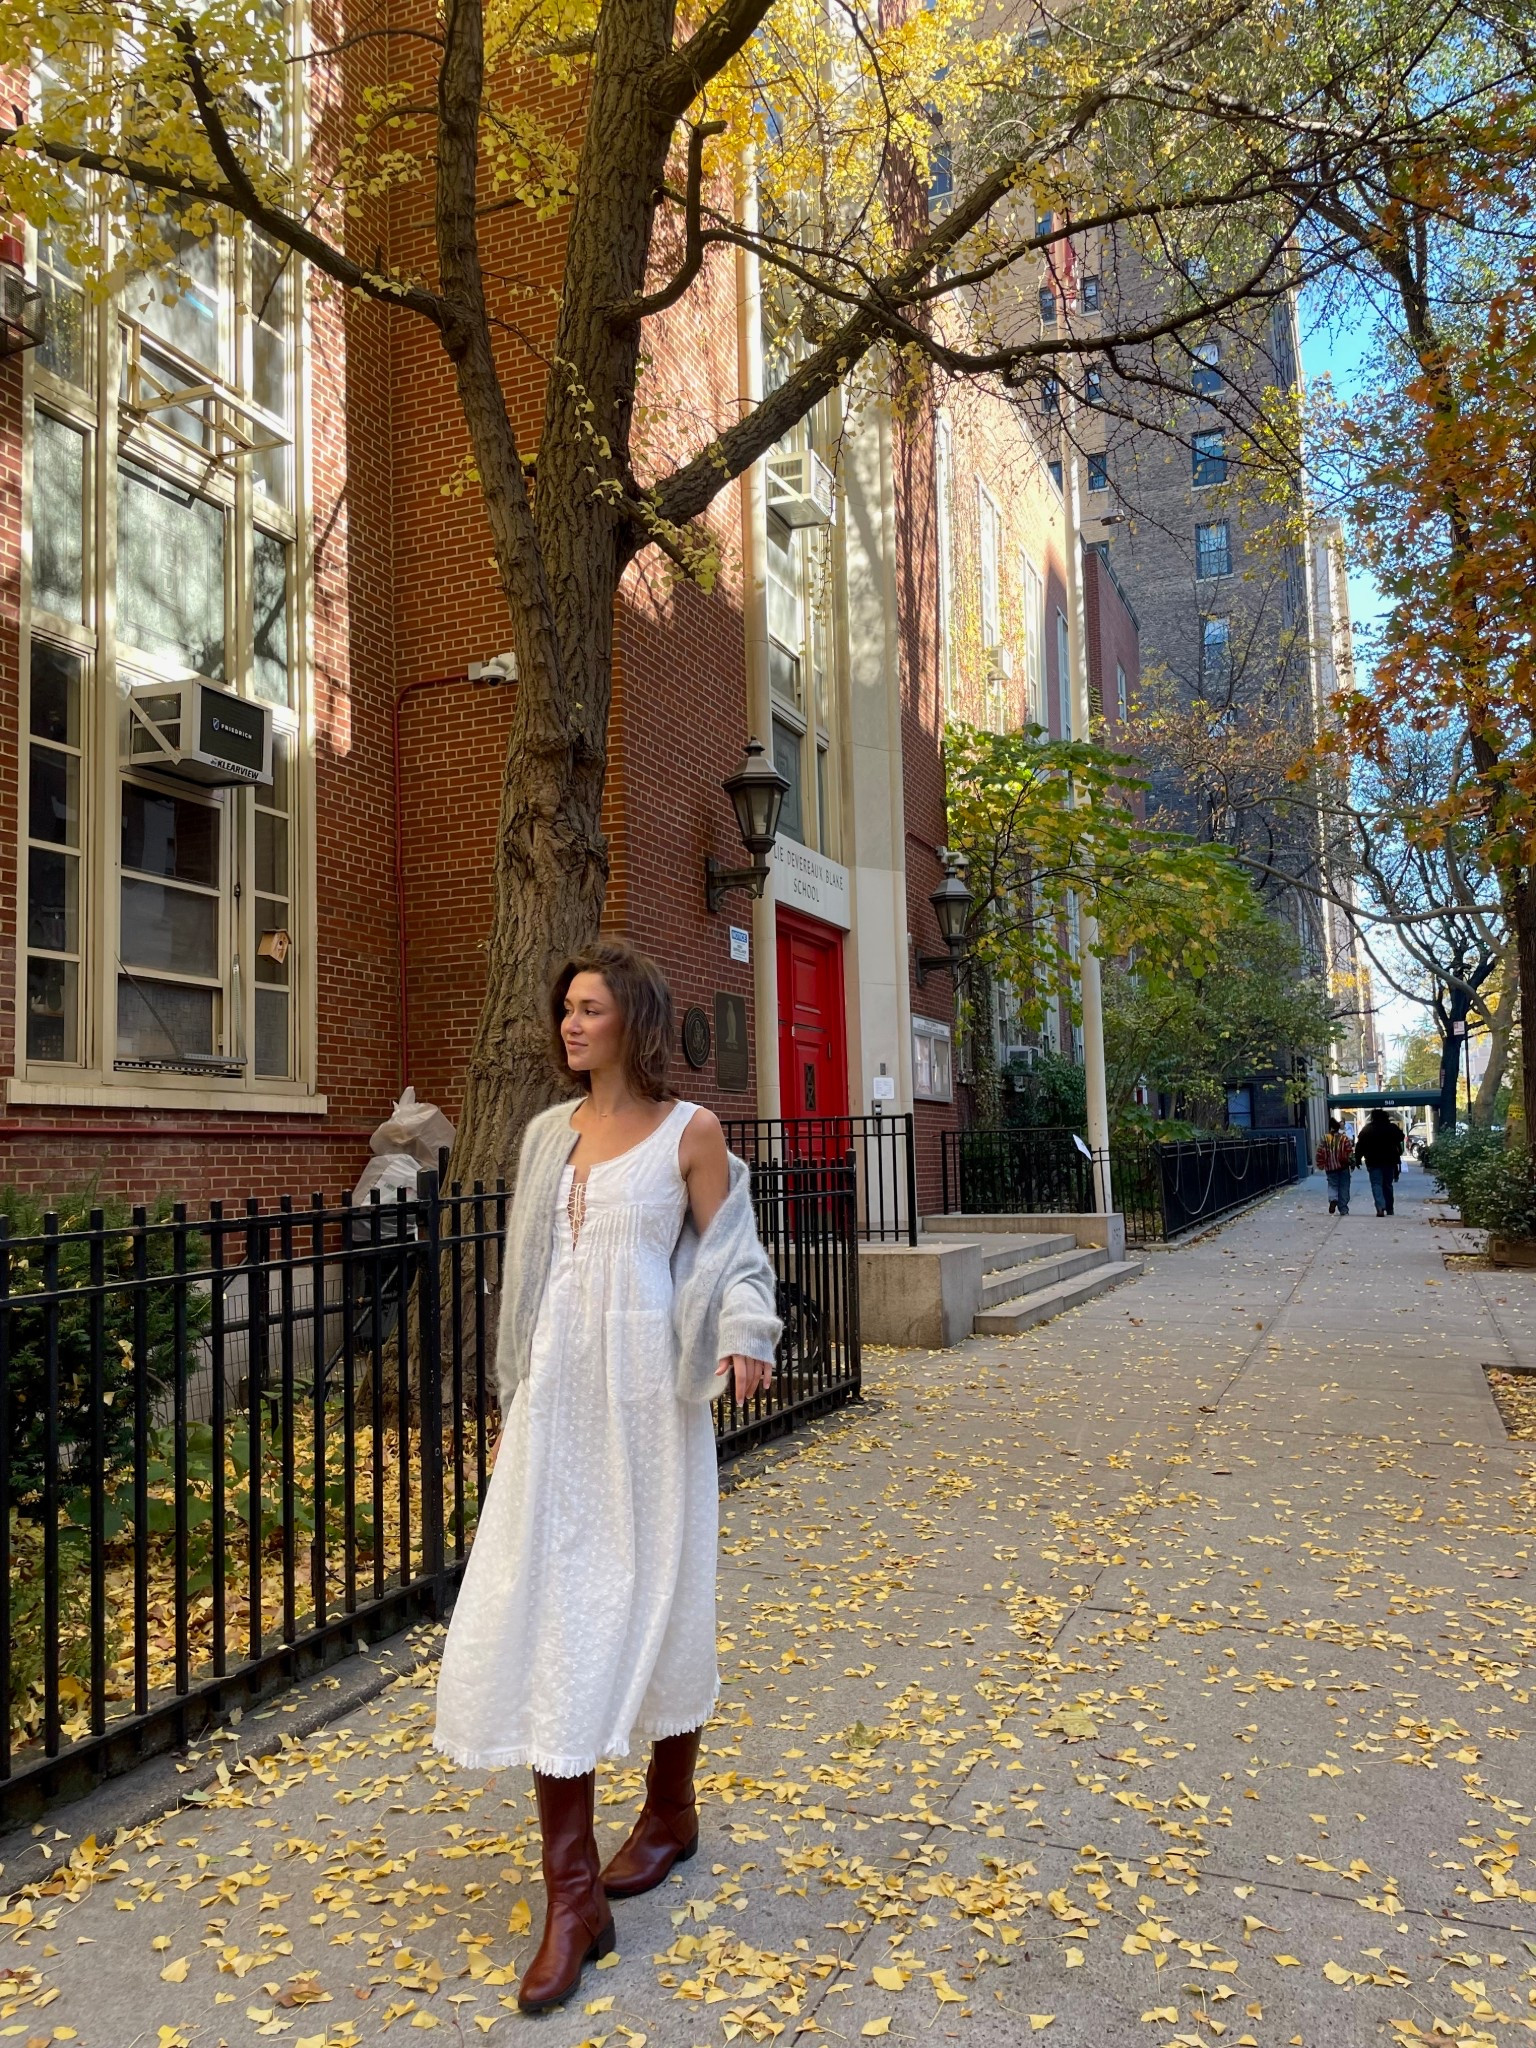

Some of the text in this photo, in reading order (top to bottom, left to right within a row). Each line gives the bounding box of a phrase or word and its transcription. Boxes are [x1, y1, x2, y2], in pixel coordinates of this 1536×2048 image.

[221, 724, 253, 740] FRIEDRICH
[217, 760, 259, 780] KLEARVIEW
[825, 868, 844, 891] BLAKE
[793, 877, 820, 903] SCHOOL
[732, 931, 747, 942] NOTICE
